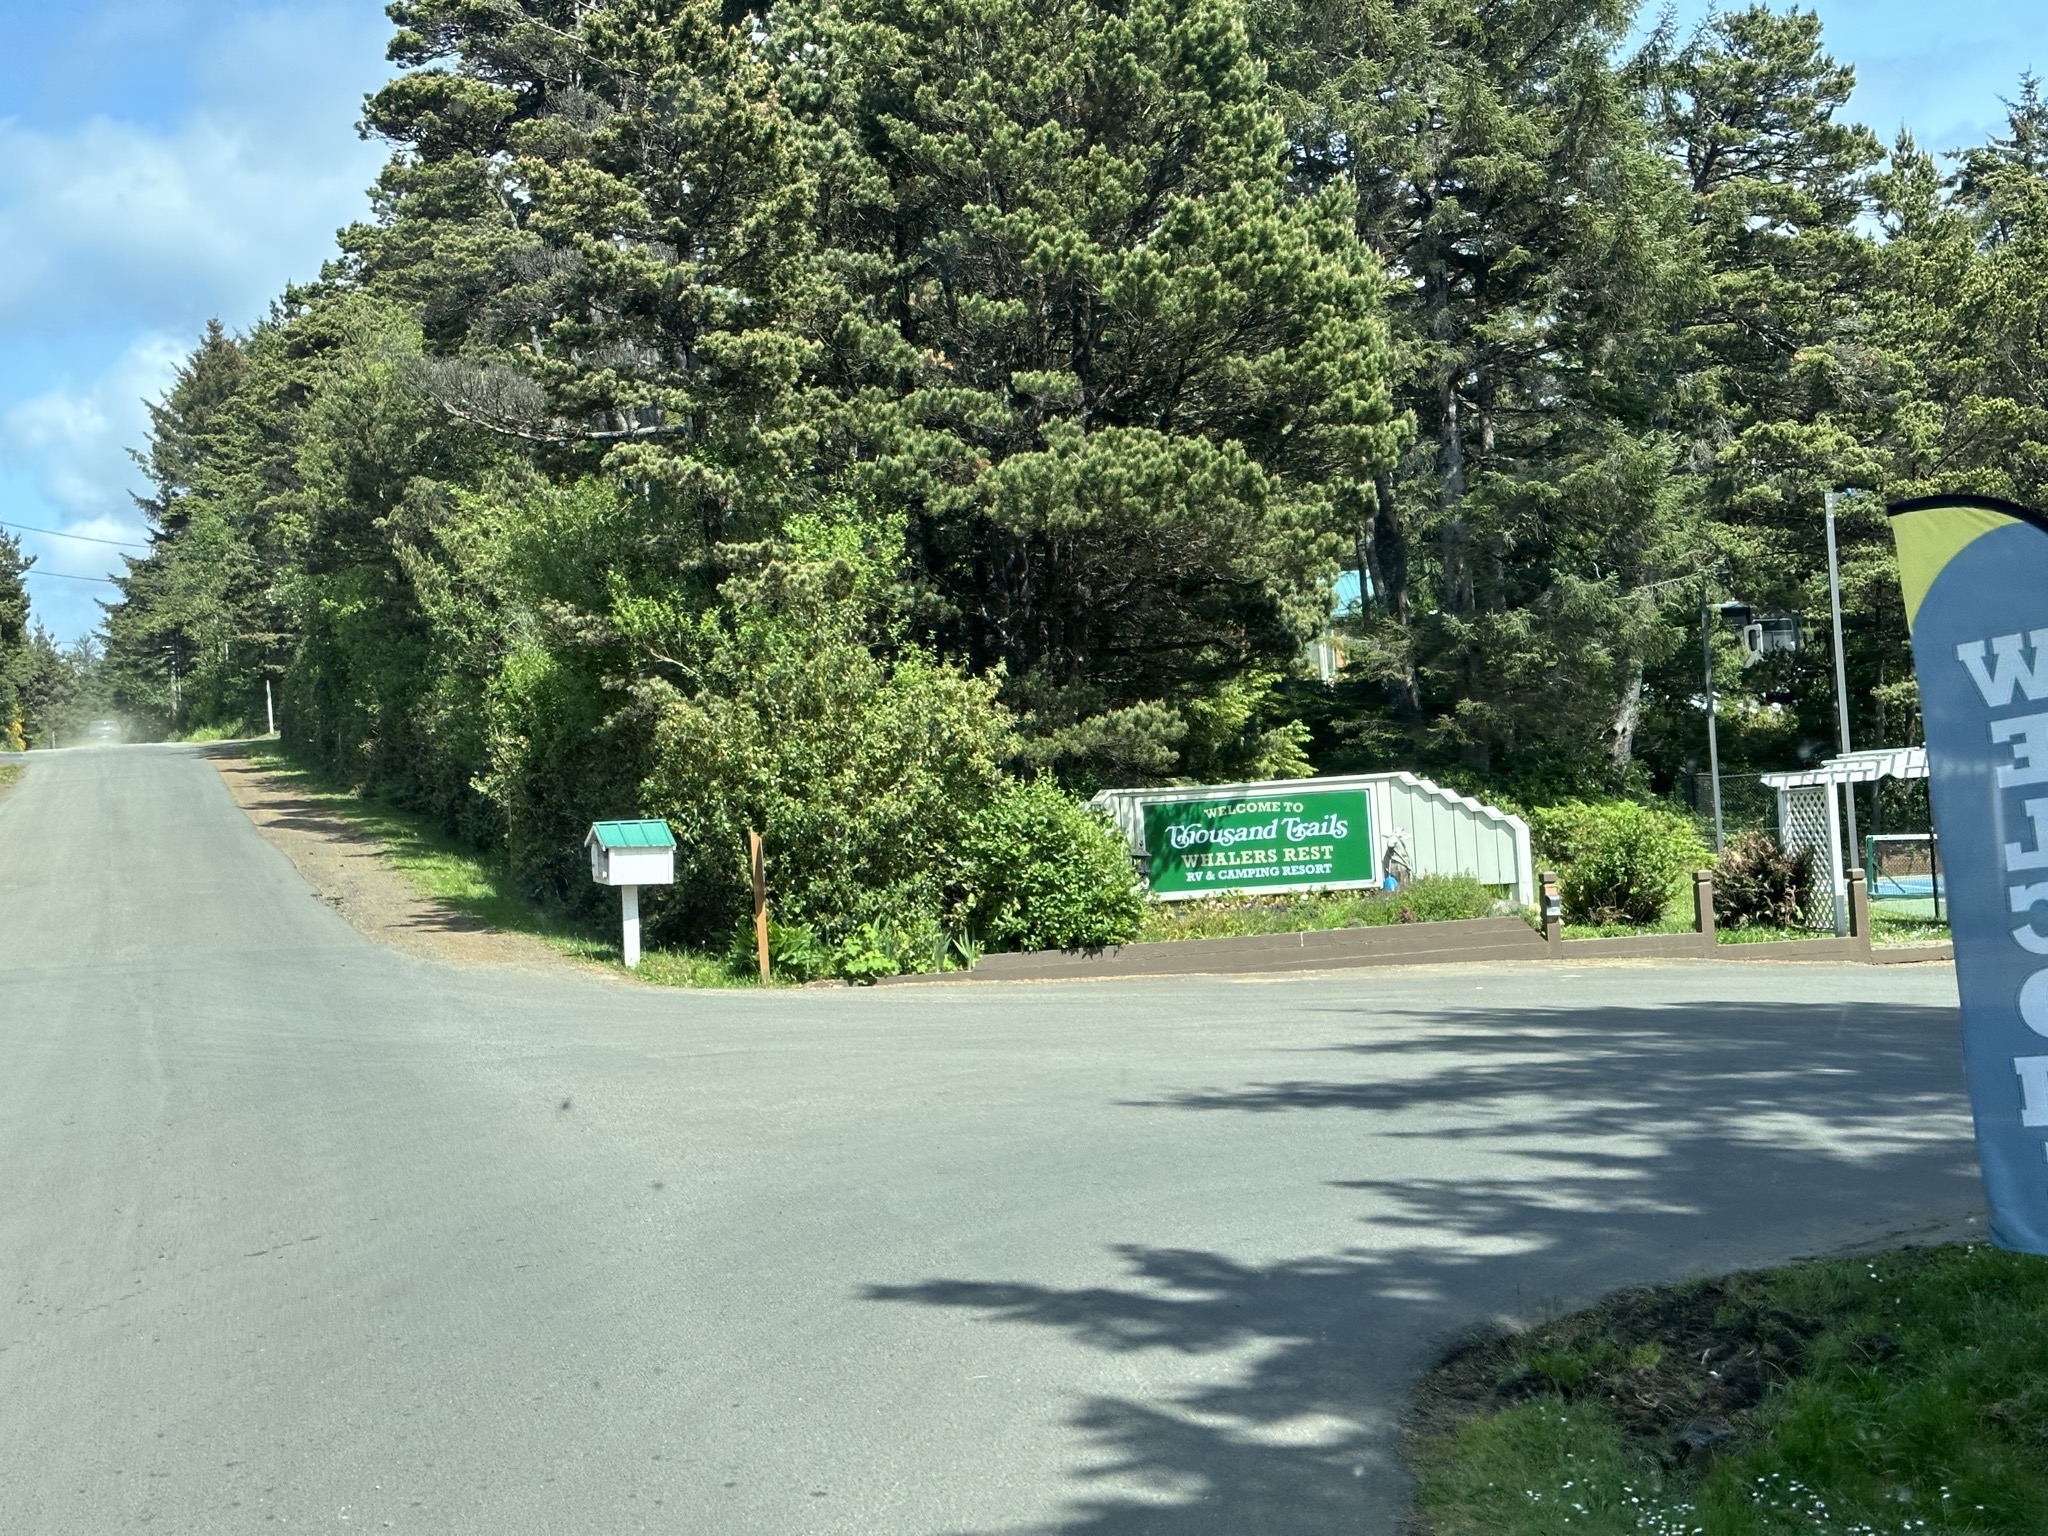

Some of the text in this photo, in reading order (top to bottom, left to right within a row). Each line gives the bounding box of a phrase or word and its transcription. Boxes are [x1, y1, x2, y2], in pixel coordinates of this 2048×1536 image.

[1204, 802, 1304, 818] WELCOME TO
[1165, 813, 1348, 849] Thousand Trails
[1181, 845, 1333, 868] WHALERS REST
[1186, 863, 1332, 882] RV & CAMPING RESORT
